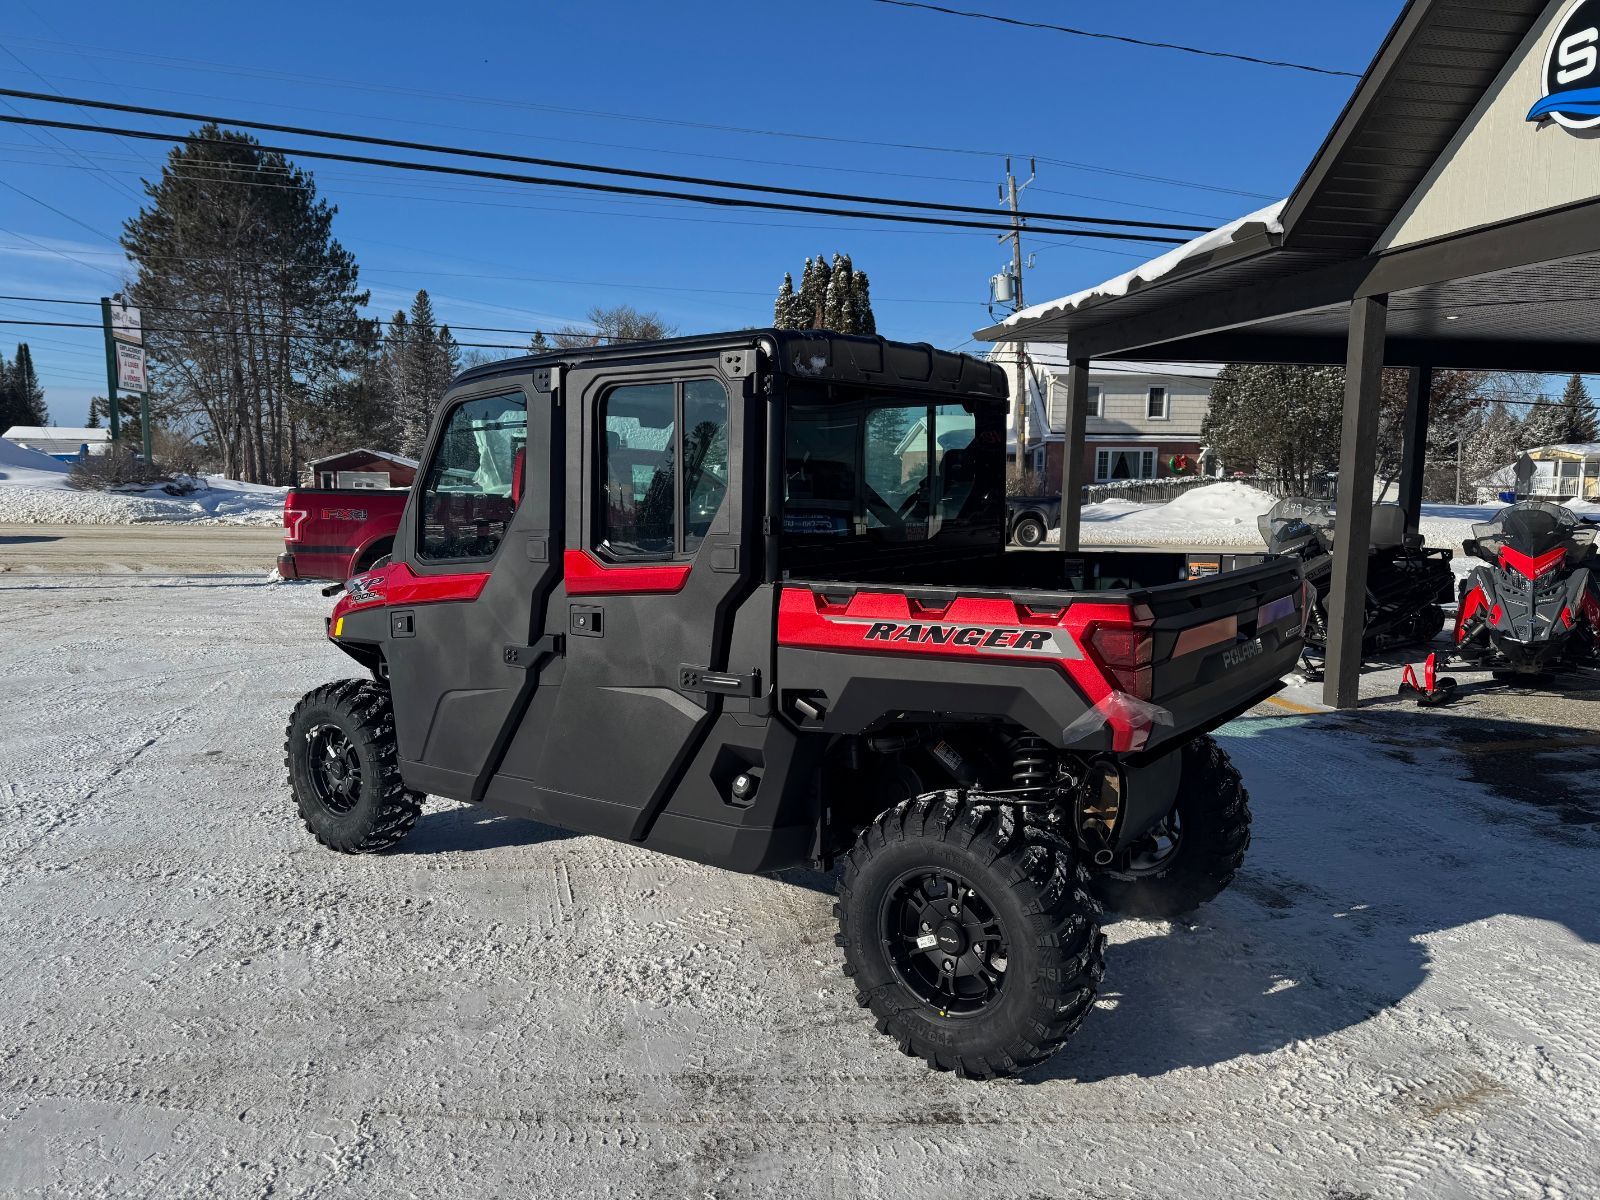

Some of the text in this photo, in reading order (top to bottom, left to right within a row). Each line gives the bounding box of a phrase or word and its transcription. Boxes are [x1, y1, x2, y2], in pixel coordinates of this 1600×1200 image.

[120, 344, 141, 355] EMPLACEMENT
[120, 351, 142, 361] COMMERCIAL
[127, 361, 139, 369] LOUER
[127, 374, 141, 383] VENDRE
[321, 508, 367, 520] FX4
[347, 576, 385, 595] XP
[353, 591, 377, 601] 1000
[864, 622, 1053, 650] RANGER
[1222, 637, 1263, 669] POLARIS
